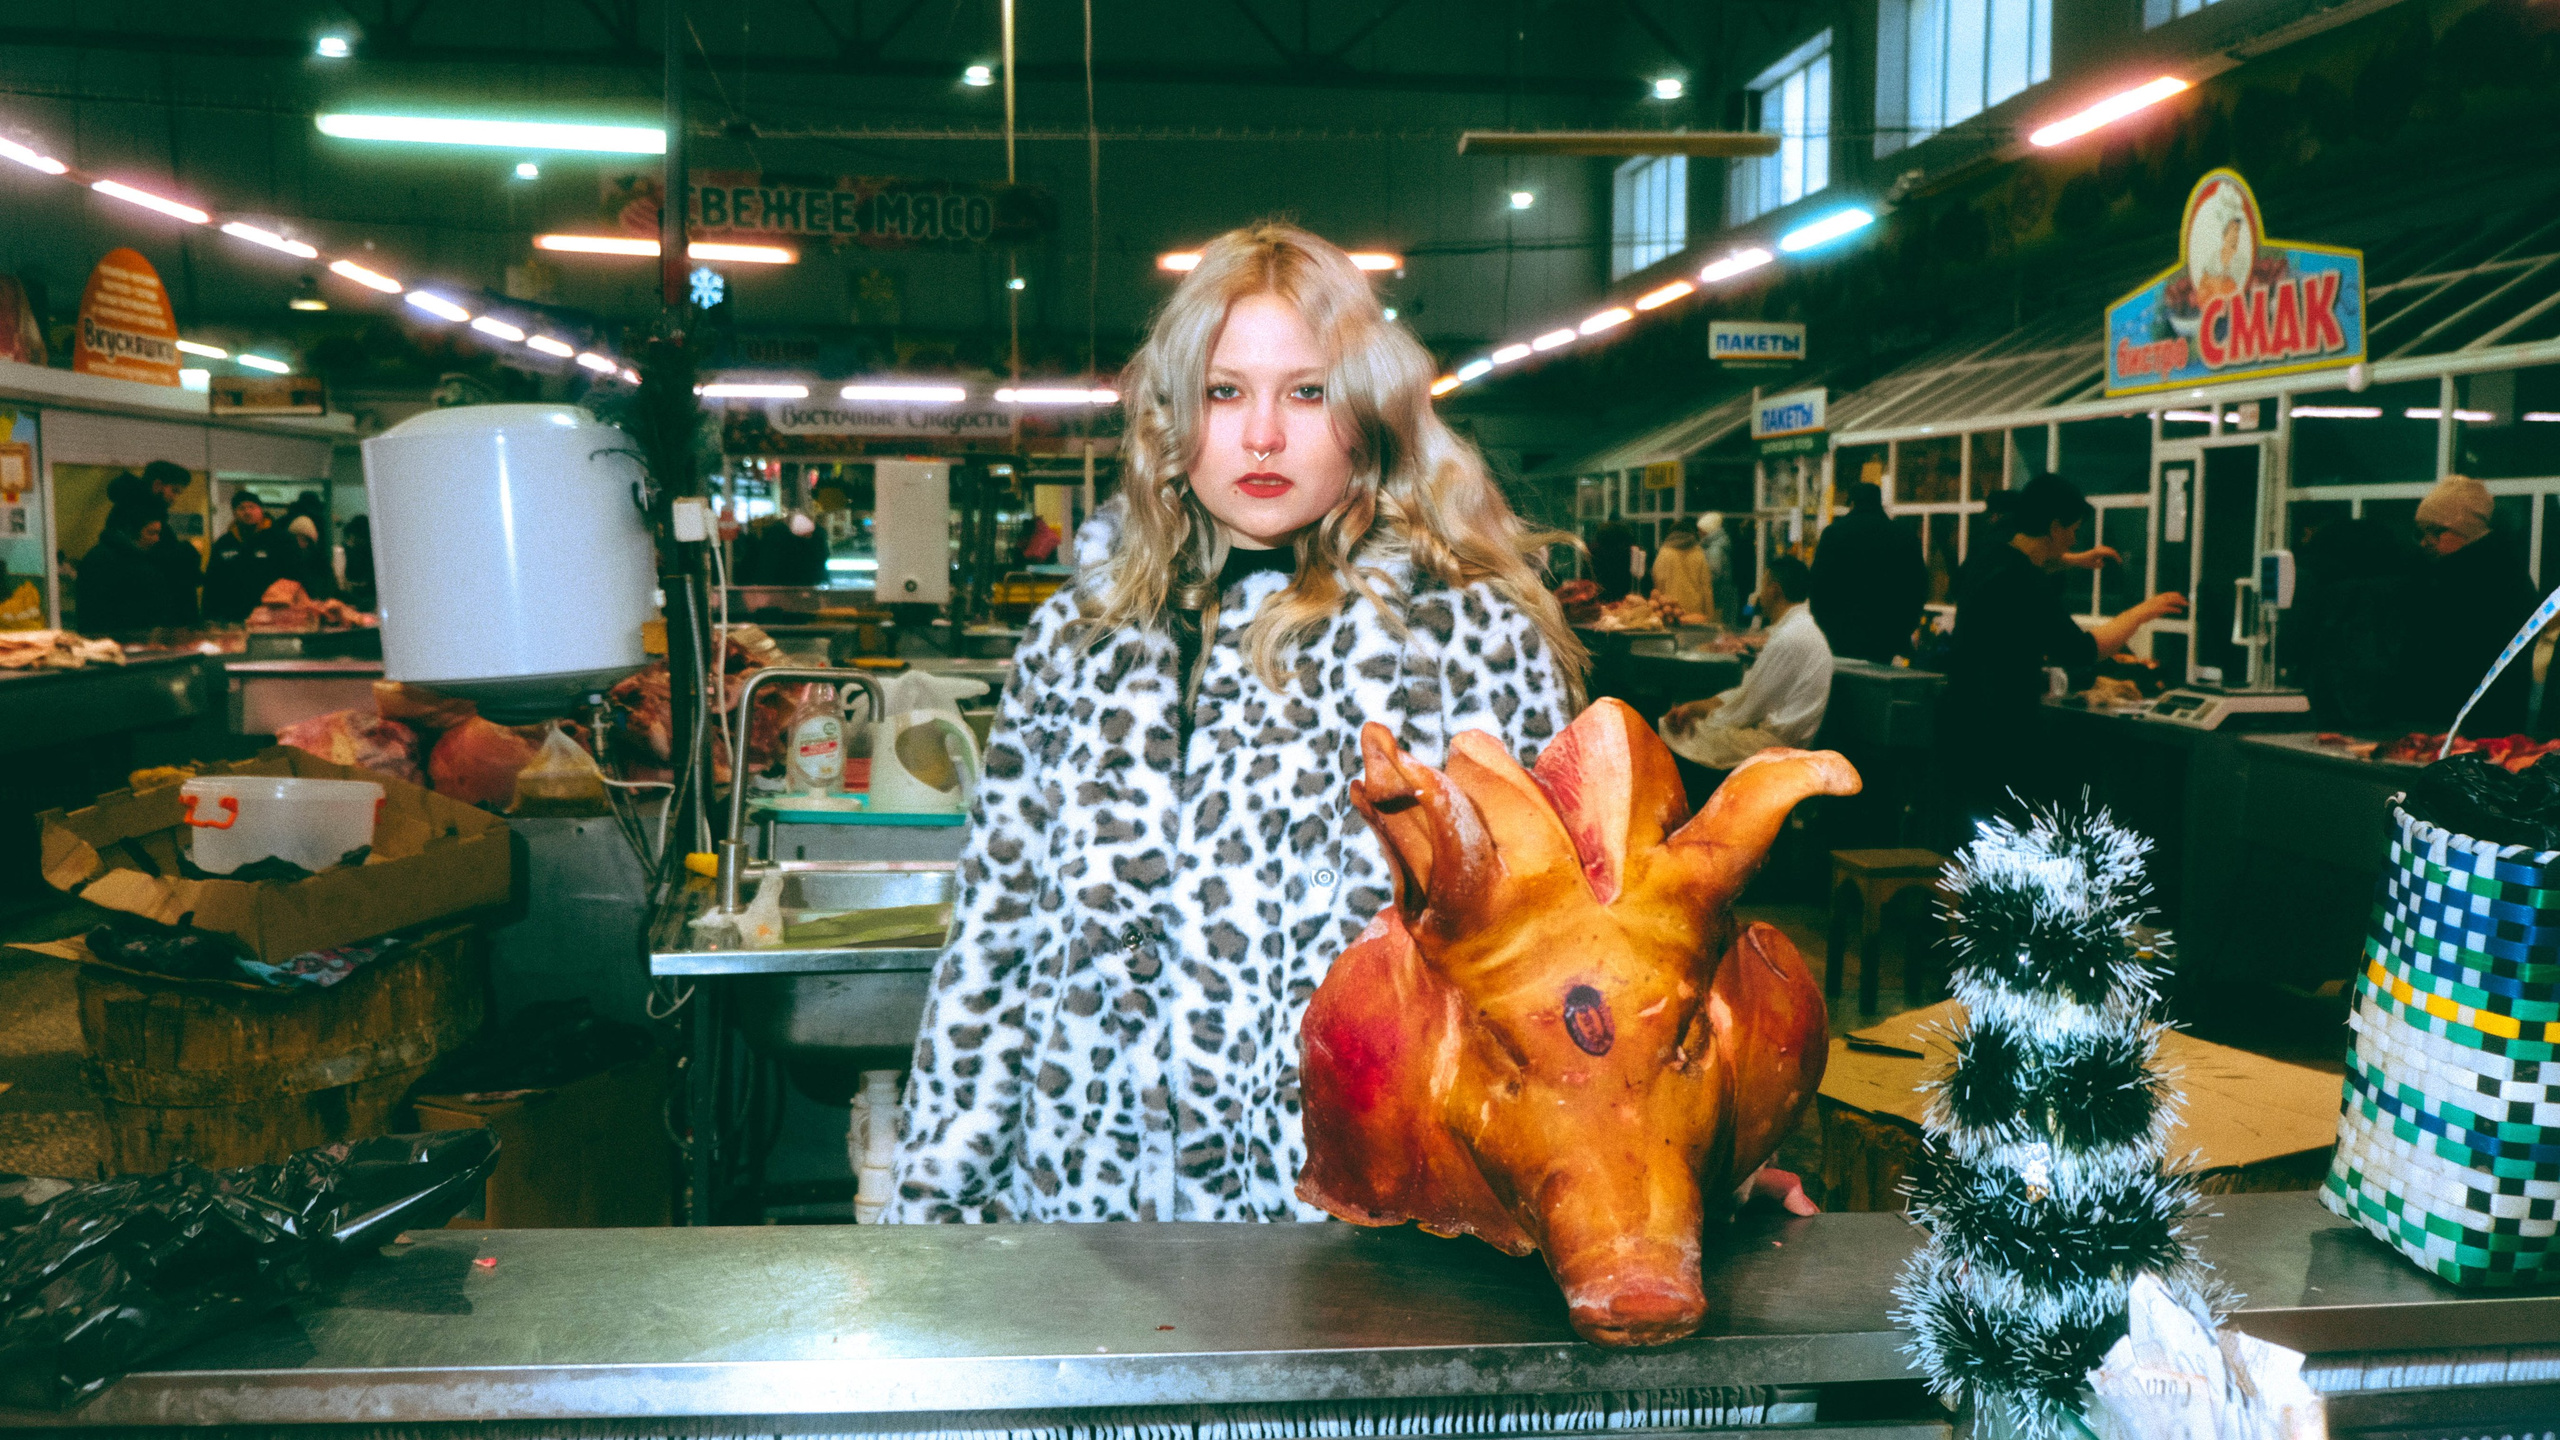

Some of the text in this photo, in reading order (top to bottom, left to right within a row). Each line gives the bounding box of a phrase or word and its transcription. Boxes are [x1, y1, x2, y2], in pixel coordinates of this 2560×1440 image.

[688, 185, 994, 241] ВЕЖЕЕ МЯСО
[2200, 270, 2345, 367] СМАК
[1716, 333, 1800, 352] ПАКЕТЫ
[1761, 403, 1813, 432] ПАКЕТЫ
